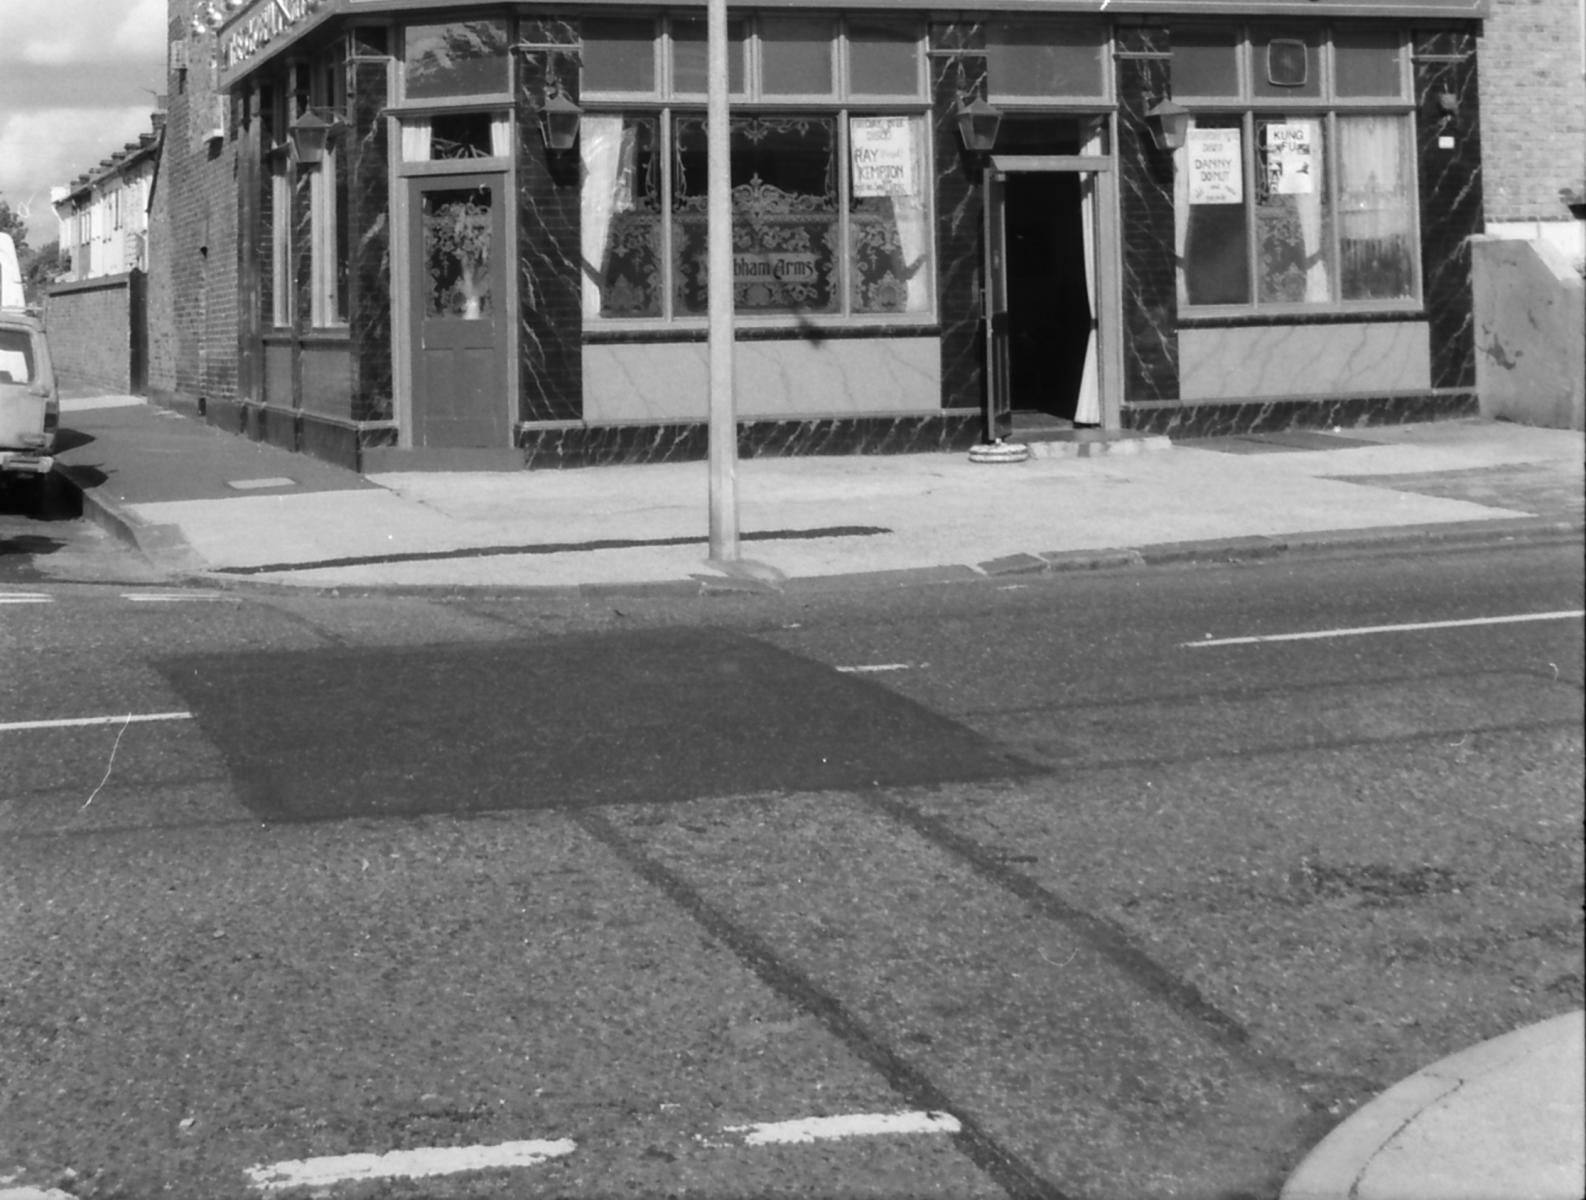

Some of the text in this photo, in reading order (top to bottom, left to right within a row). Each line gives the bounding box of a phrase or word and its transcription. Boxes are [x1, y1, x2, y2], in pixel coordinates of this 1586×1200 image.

[1273, 129, 1304, 140] KUNG
[854, 148, 879, 163] RAY
[1195, 159, 1232, 170] DANNY
[772, 259, 814, 280] Arms
